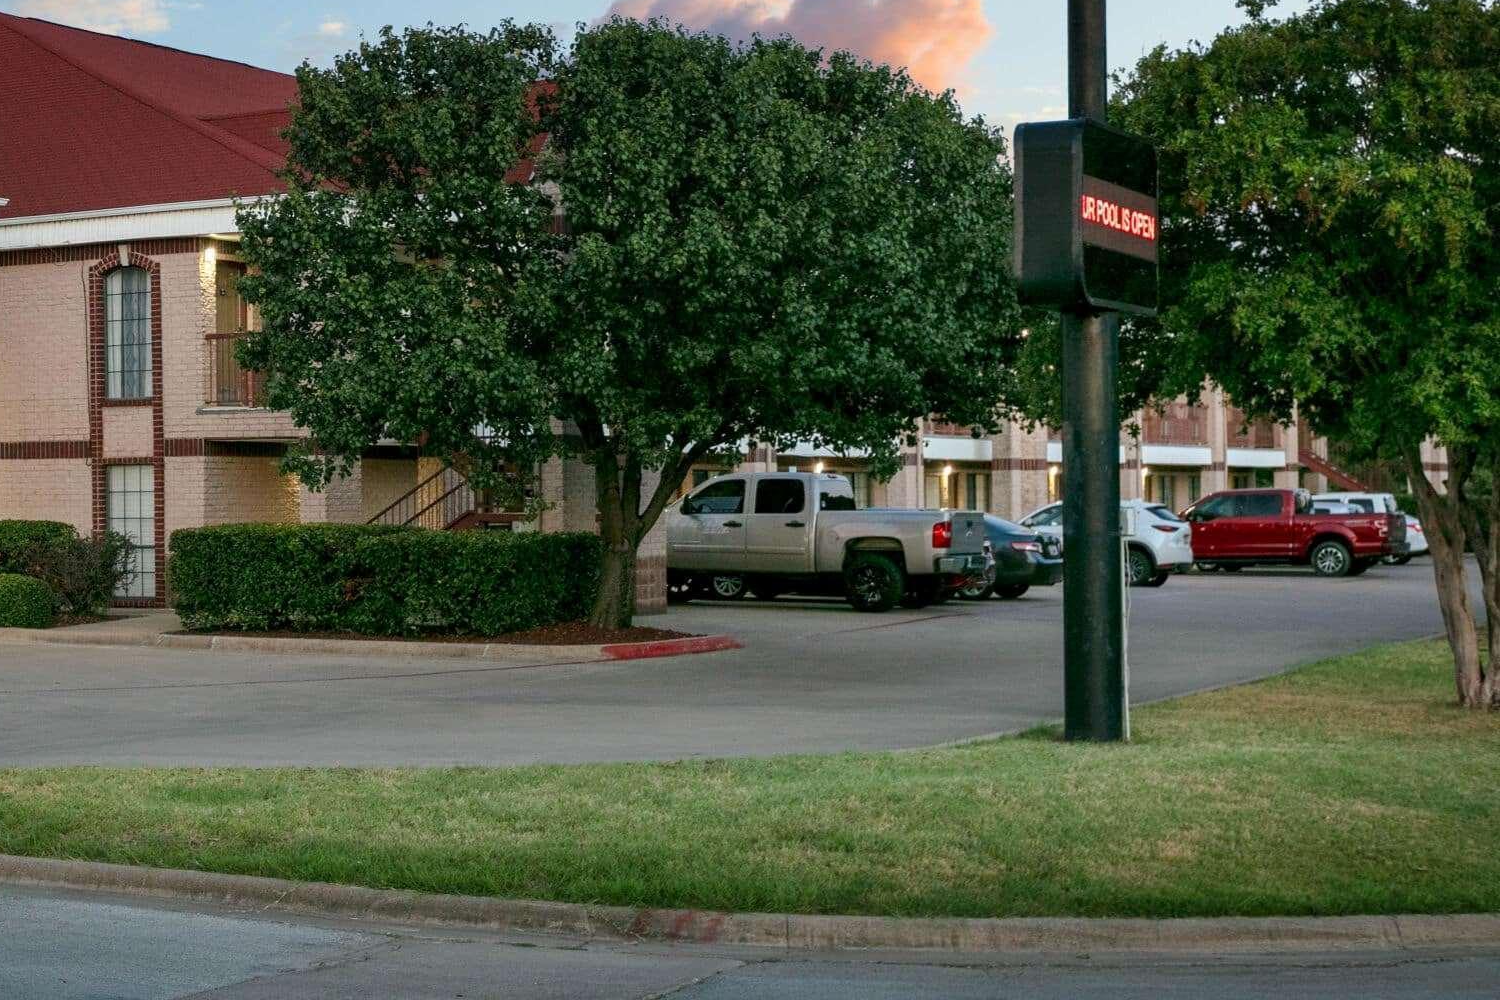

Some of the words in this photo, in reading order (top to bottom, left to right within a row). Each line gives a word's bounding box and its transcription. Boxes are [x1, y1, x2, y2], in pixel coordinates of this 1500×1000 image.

[1096, 199, 1121, 229] POOL
[1122, 207, 1130, 232] IS
[1131, 211, 1155, 240] OPEN
